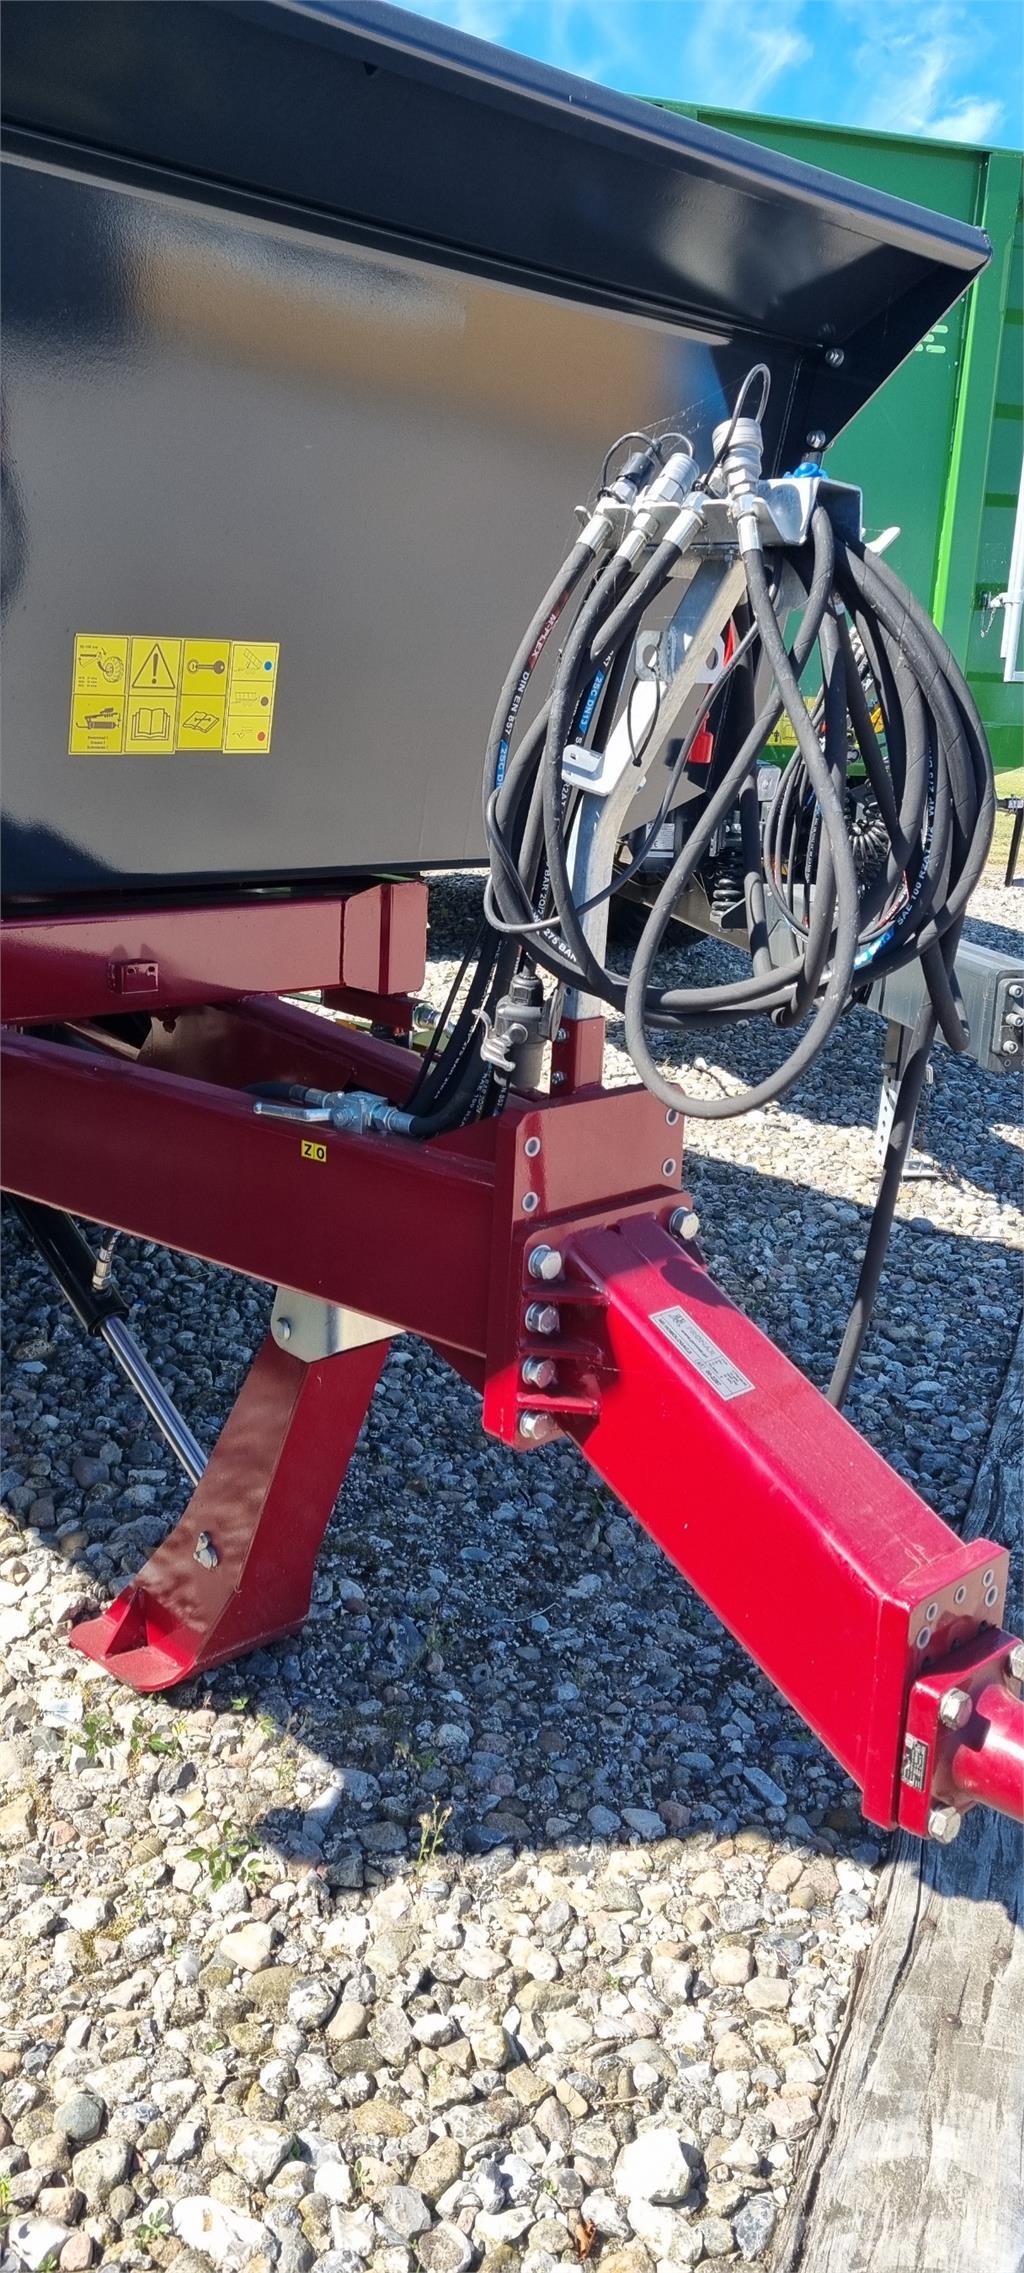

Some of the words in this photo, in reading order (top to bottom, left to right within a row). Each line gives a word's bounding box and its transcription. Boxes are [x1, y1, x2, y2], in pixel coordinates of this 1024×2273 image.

[517, 671, 530, 692] DIN
[590, 675, 602, 697] 2SC
[510, 695, 521, 712] EN
[579, 699, 595, 725] DN13
[504, 715, 515, 735] 857
[498, 746, 508, 771] 2SC
[541, 869, 551, 891] BAR
[897, 904, 913, 926] SAE
[911, 881, 923, 900] 100
[543, 928, 560, 944] 275
